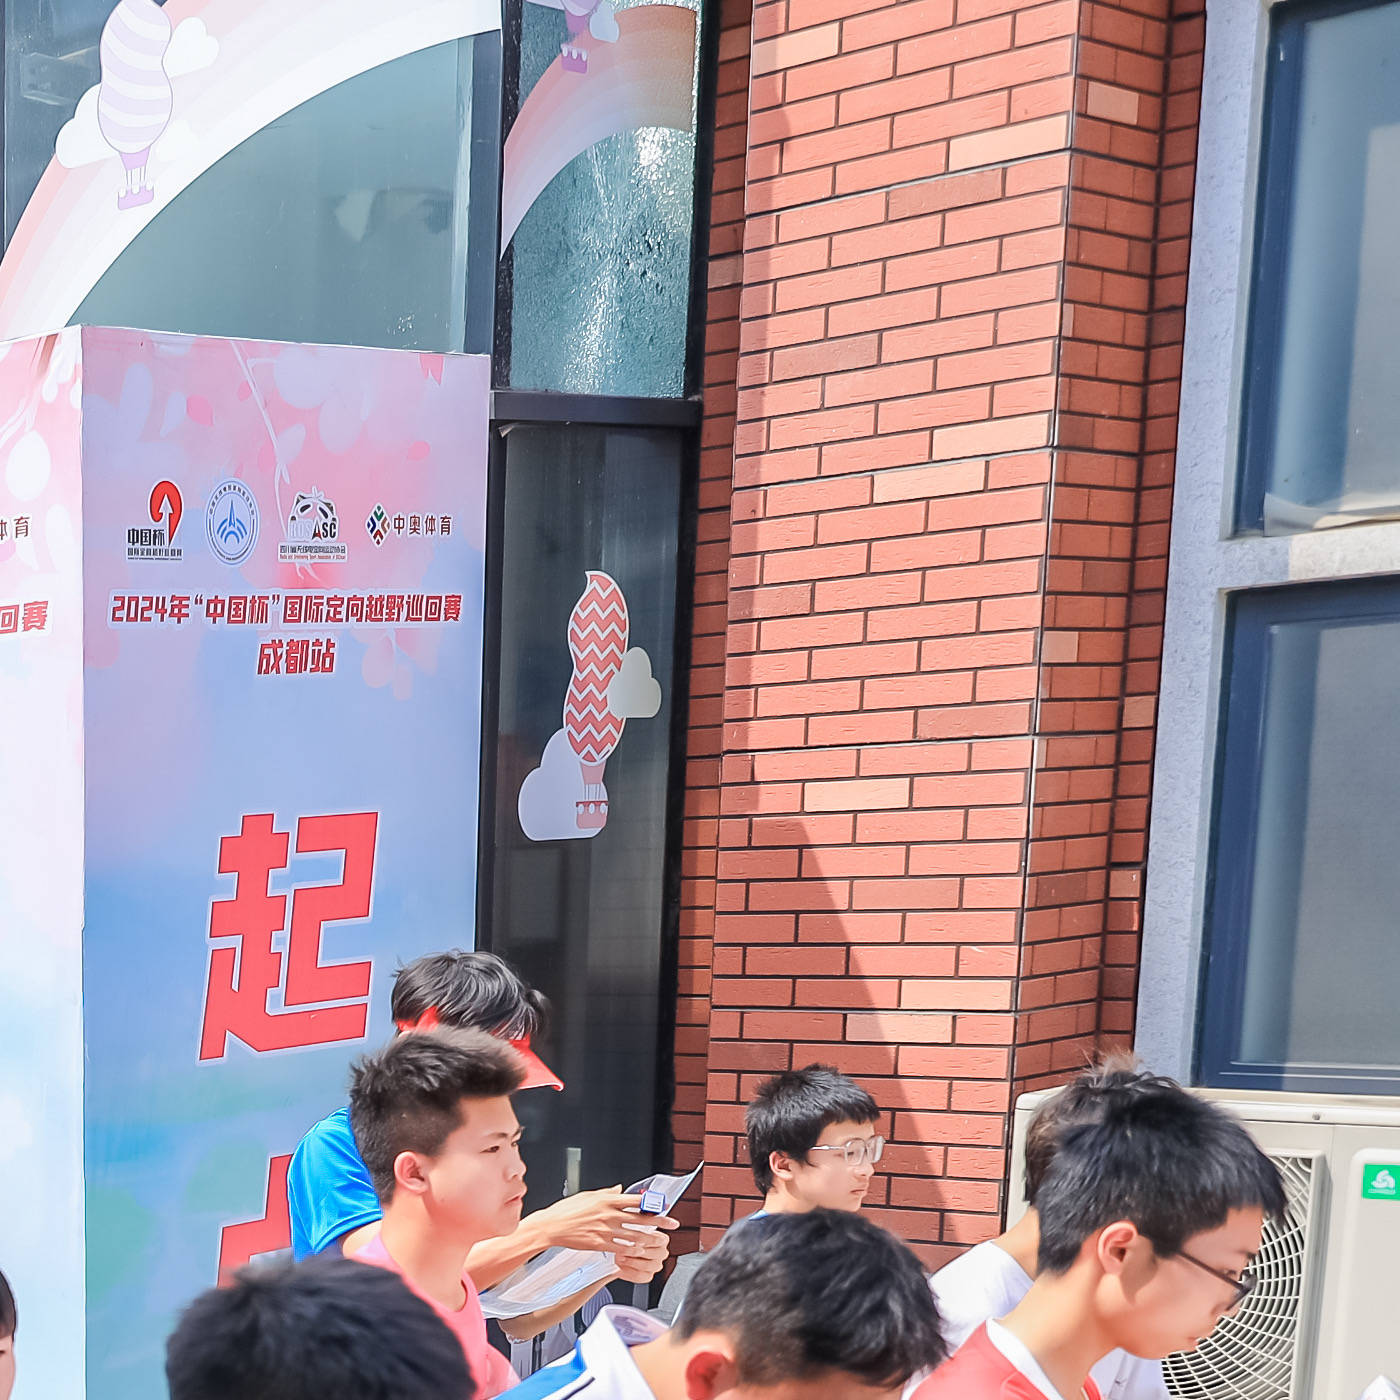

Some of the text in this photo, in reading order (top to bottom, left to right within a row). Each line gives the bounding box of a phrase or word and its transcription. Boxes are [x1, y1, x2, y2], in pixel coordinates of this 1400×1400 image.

[393, 513, 452, 536] 中奥体育
[127, 527, 166, 547] 中国杯
[256, 638, 337, 675] 成都站
